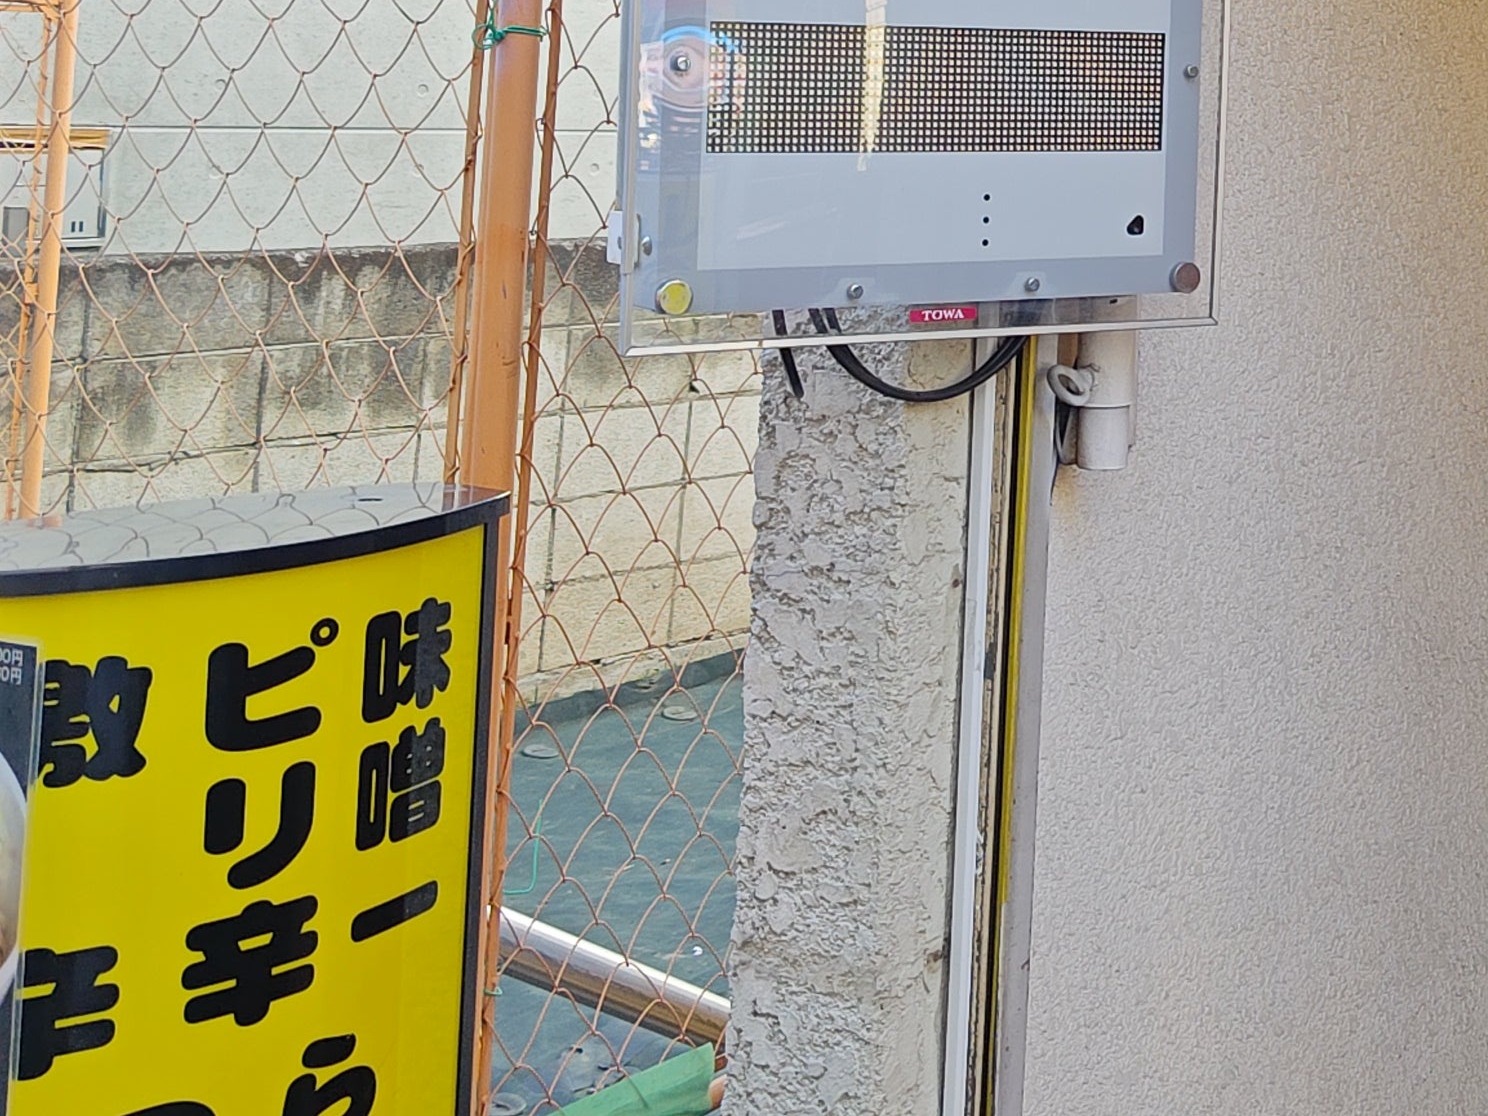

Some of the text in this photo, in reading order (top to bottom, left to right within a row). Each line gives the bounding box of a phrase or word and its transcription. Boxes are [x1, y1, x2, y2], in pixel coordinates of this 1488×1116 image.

[922, 309, 965, 321] TOWA
[181, 617, 340, 1027] ピリ辛
[350, 596, 452, 943] 味噌一
